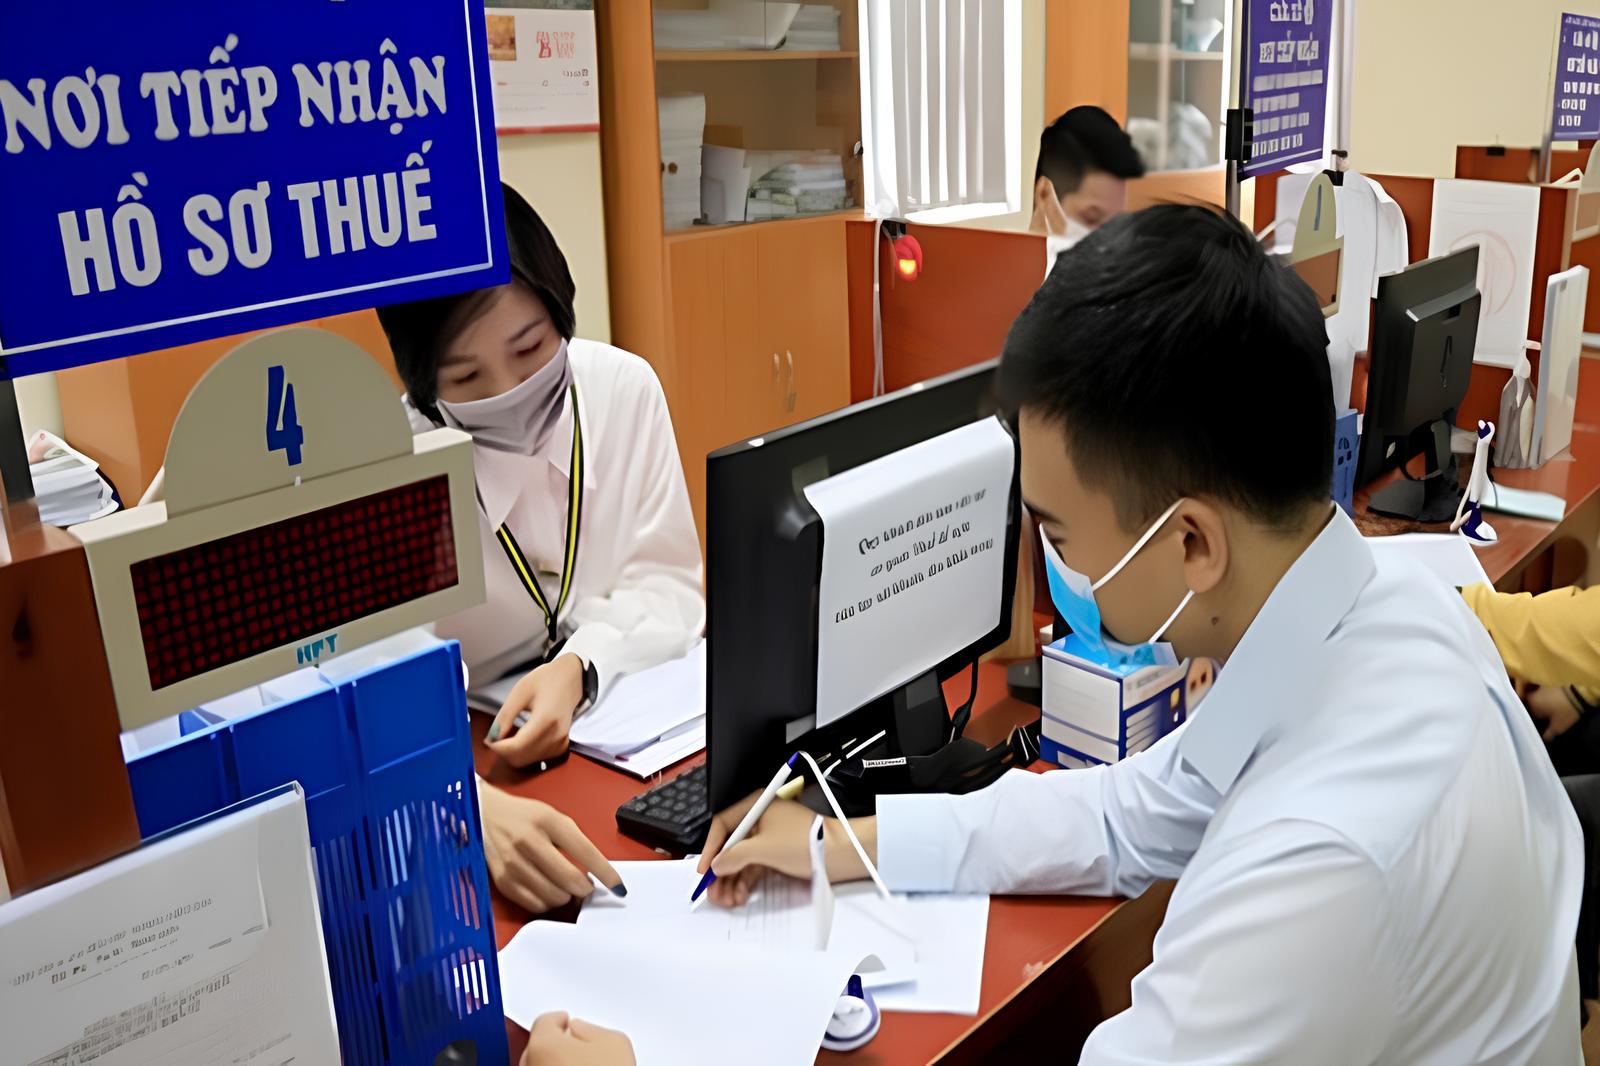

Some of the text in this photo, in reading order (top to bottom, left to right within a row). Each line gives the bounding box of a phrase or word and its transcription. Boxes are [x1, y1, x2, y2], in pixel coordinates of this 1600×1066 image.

[0, 33, 447, 154] NƠI TIẾP NHẬN
[58, 139, 438, 296] HỒ SƠ THUẾ
[265, 365, 304, 467] 4
